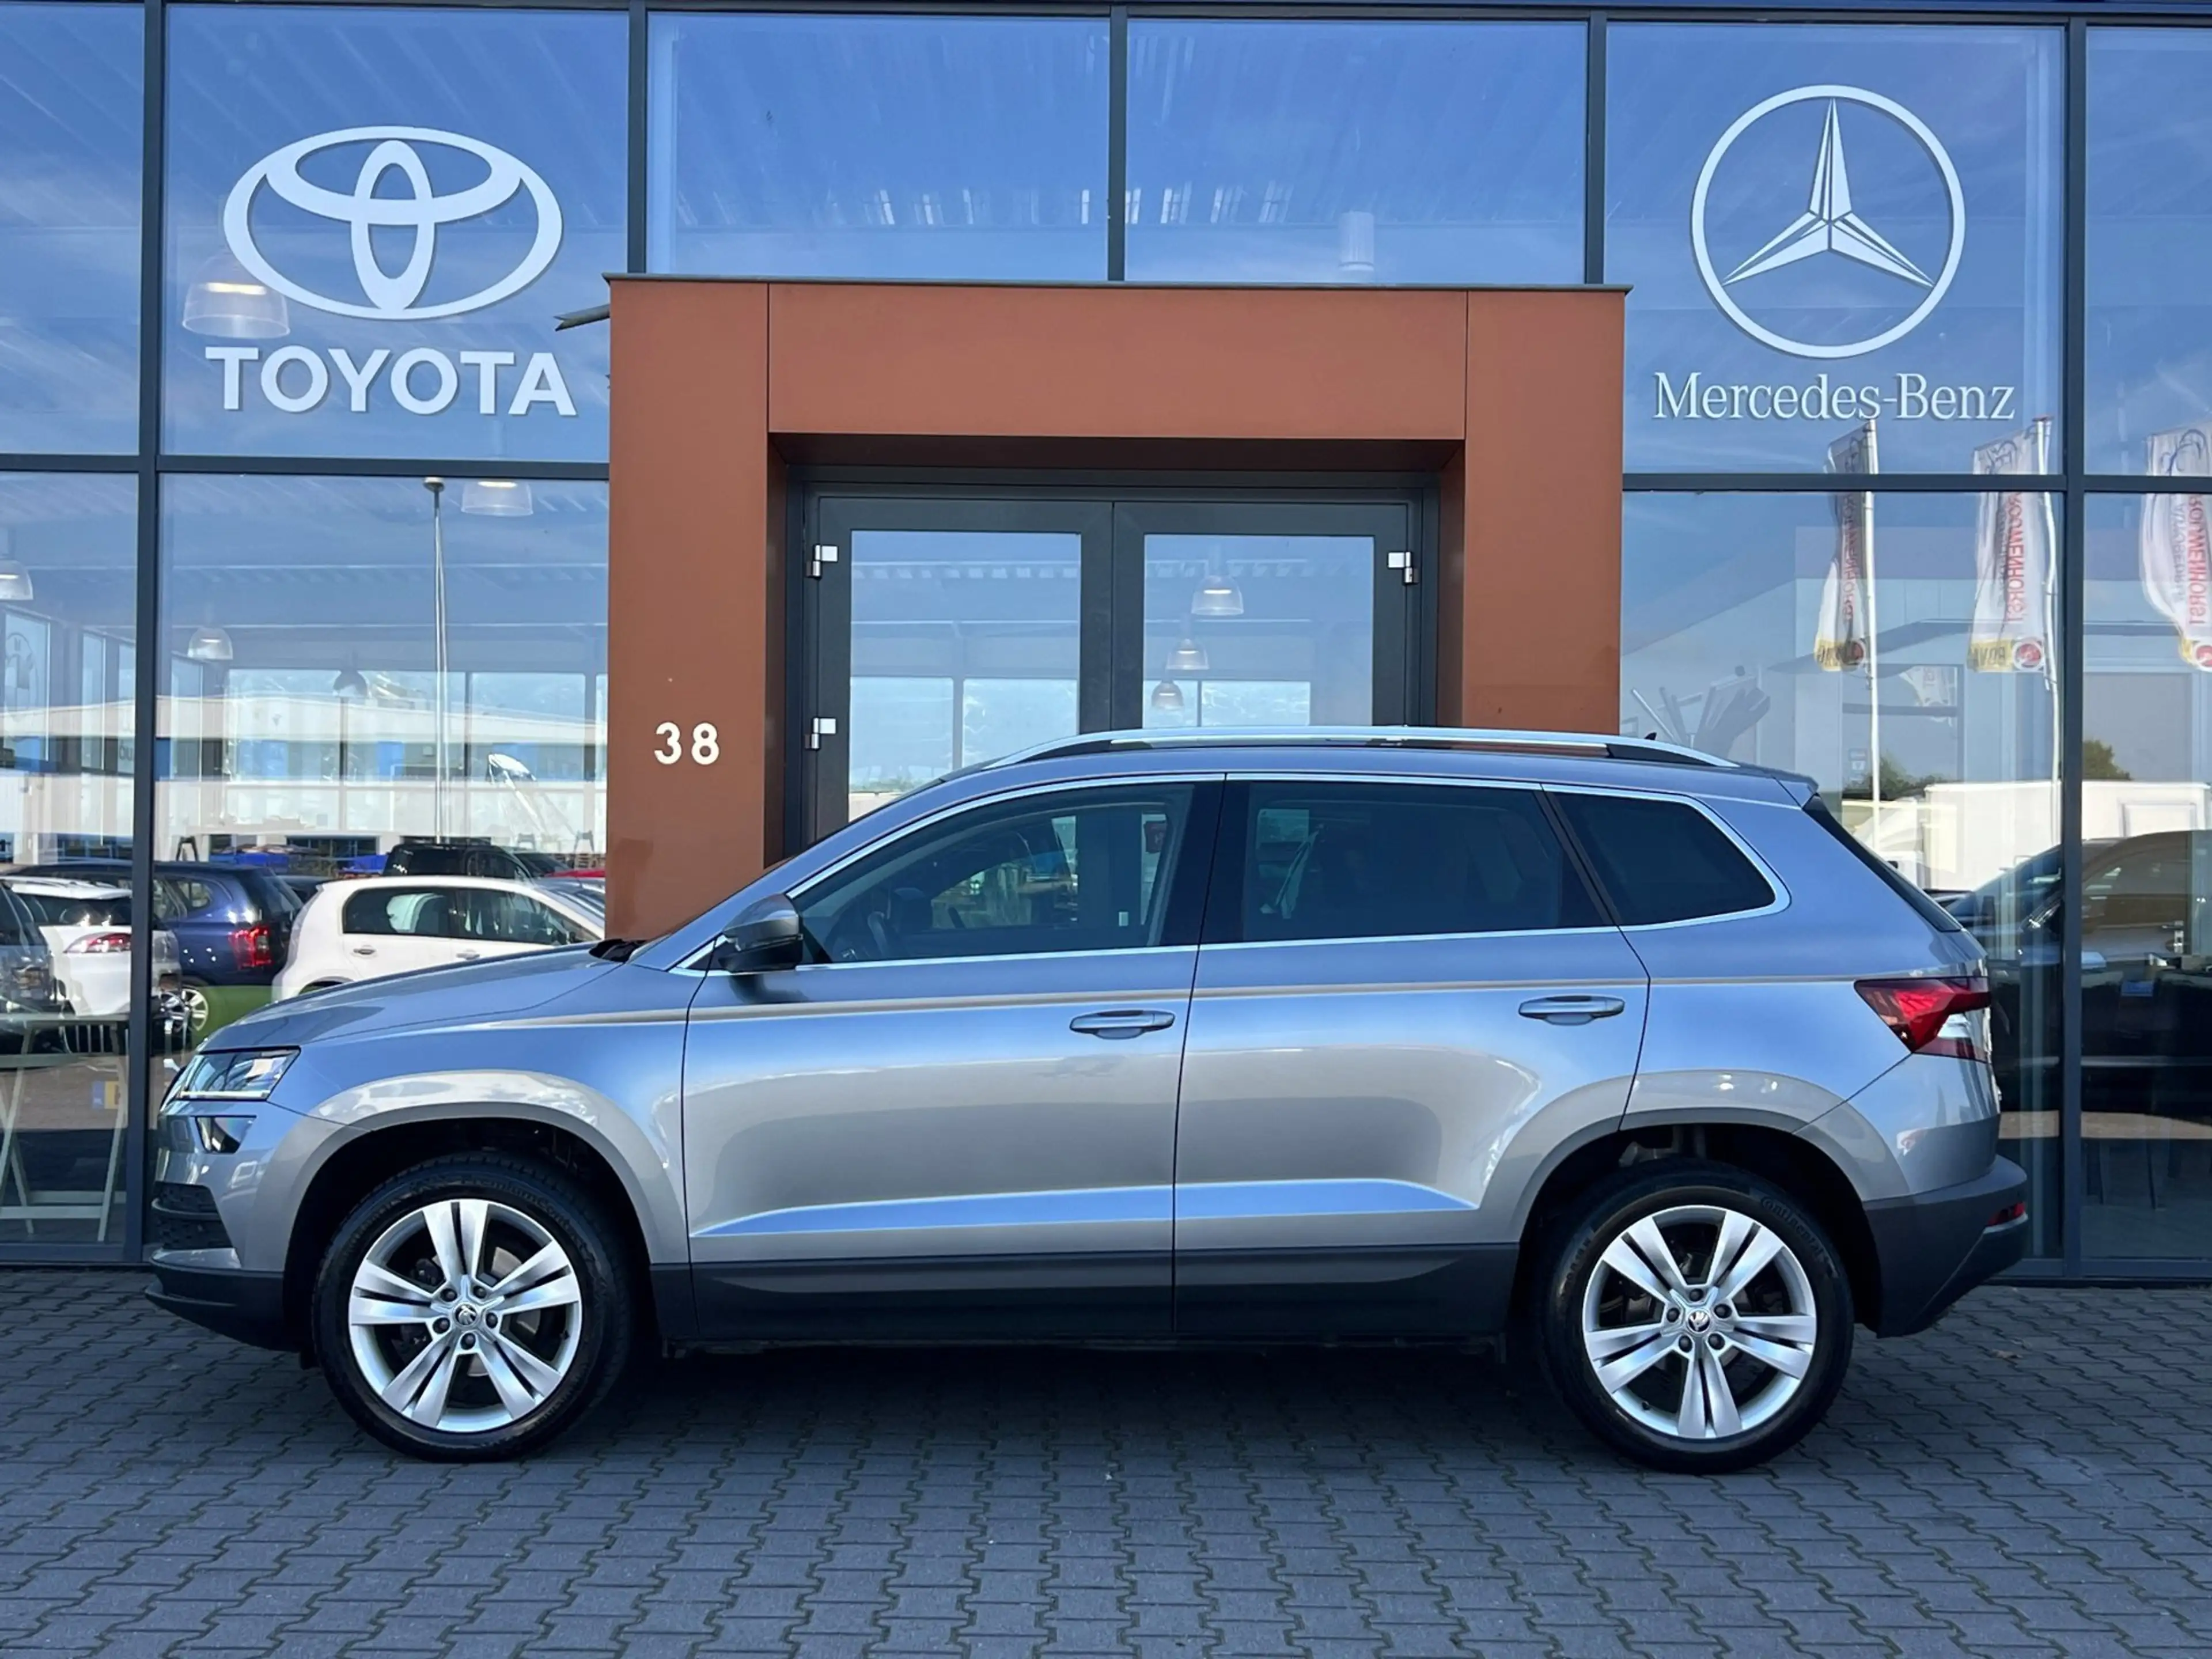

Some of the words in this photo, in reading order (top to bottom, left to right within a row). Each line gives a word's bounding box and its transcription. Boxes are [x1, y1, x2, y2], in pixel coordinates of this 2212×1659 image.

[205, 345, 577, 416] TOYOTA
[1652, 372, 2015, 420] Mercedes-Benz
[654, 722, 720, 765] 38
